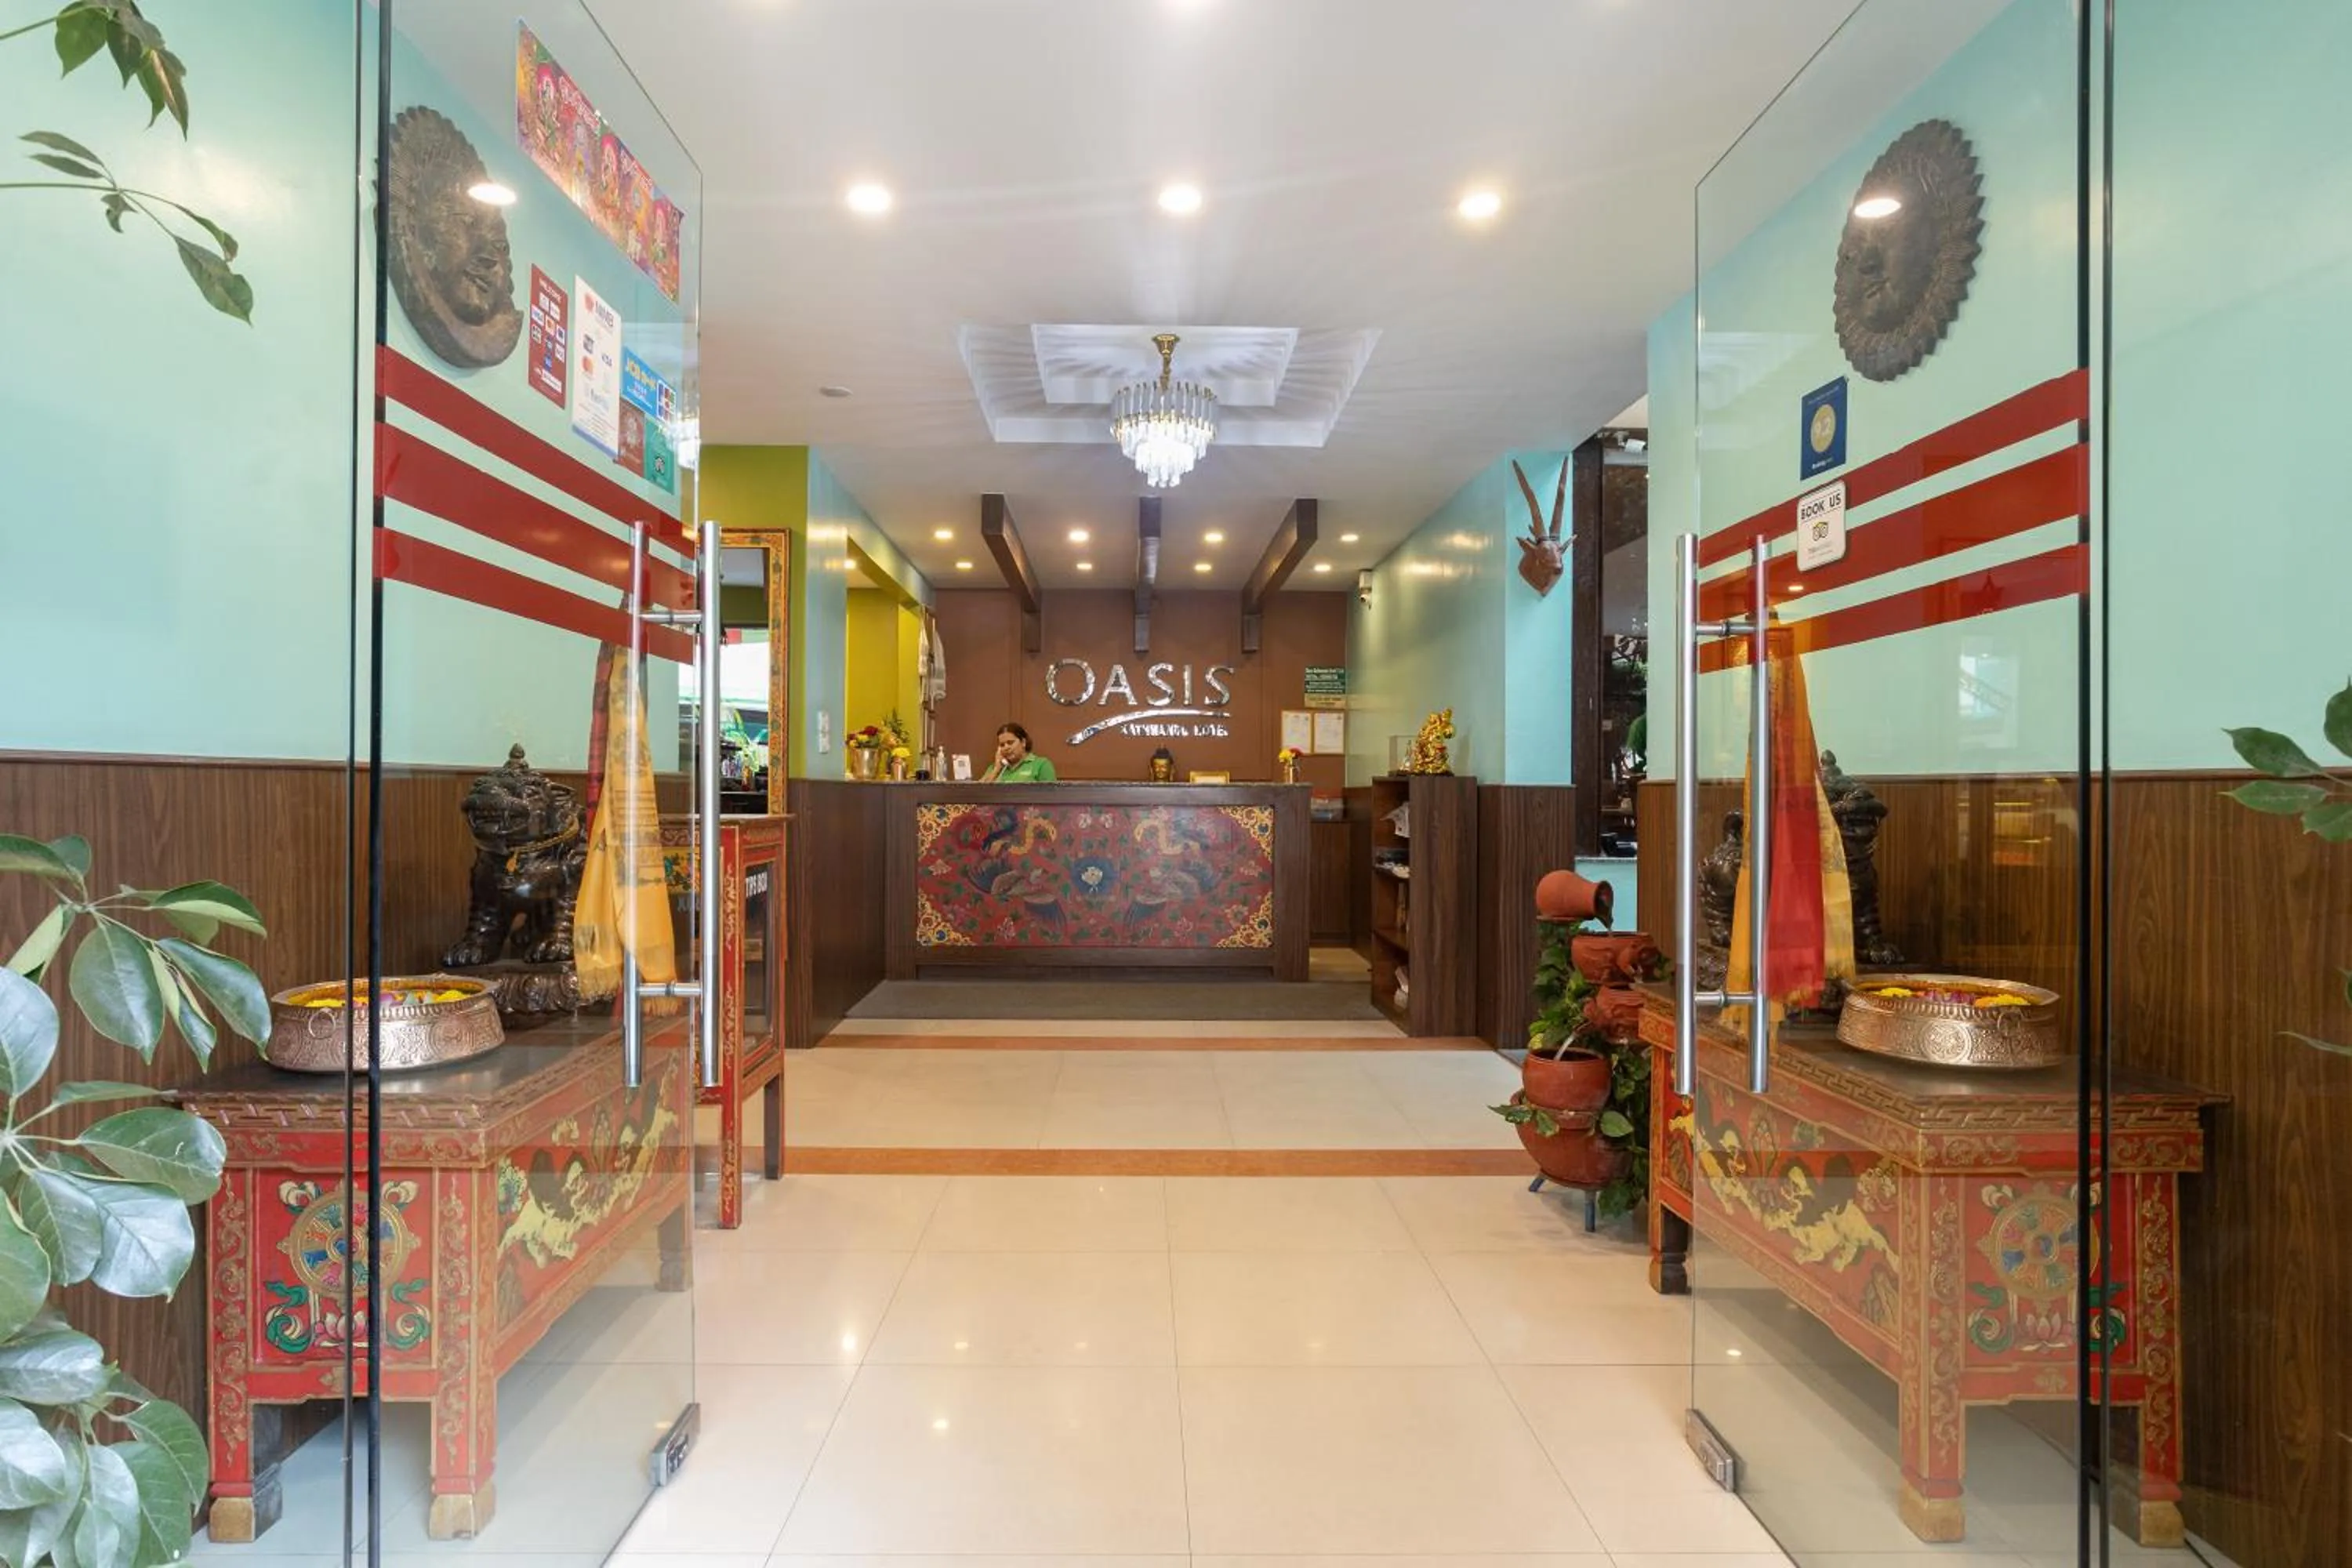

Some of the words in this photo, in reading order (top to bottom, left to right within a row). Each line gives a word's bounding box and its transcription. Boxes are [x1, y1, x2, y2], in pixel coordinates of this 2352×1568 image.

[1801, 500, 1825, 520] BOOK
[1829, 493, 1842, 508] US
[1045, 658, 1235, 706] OASIS
